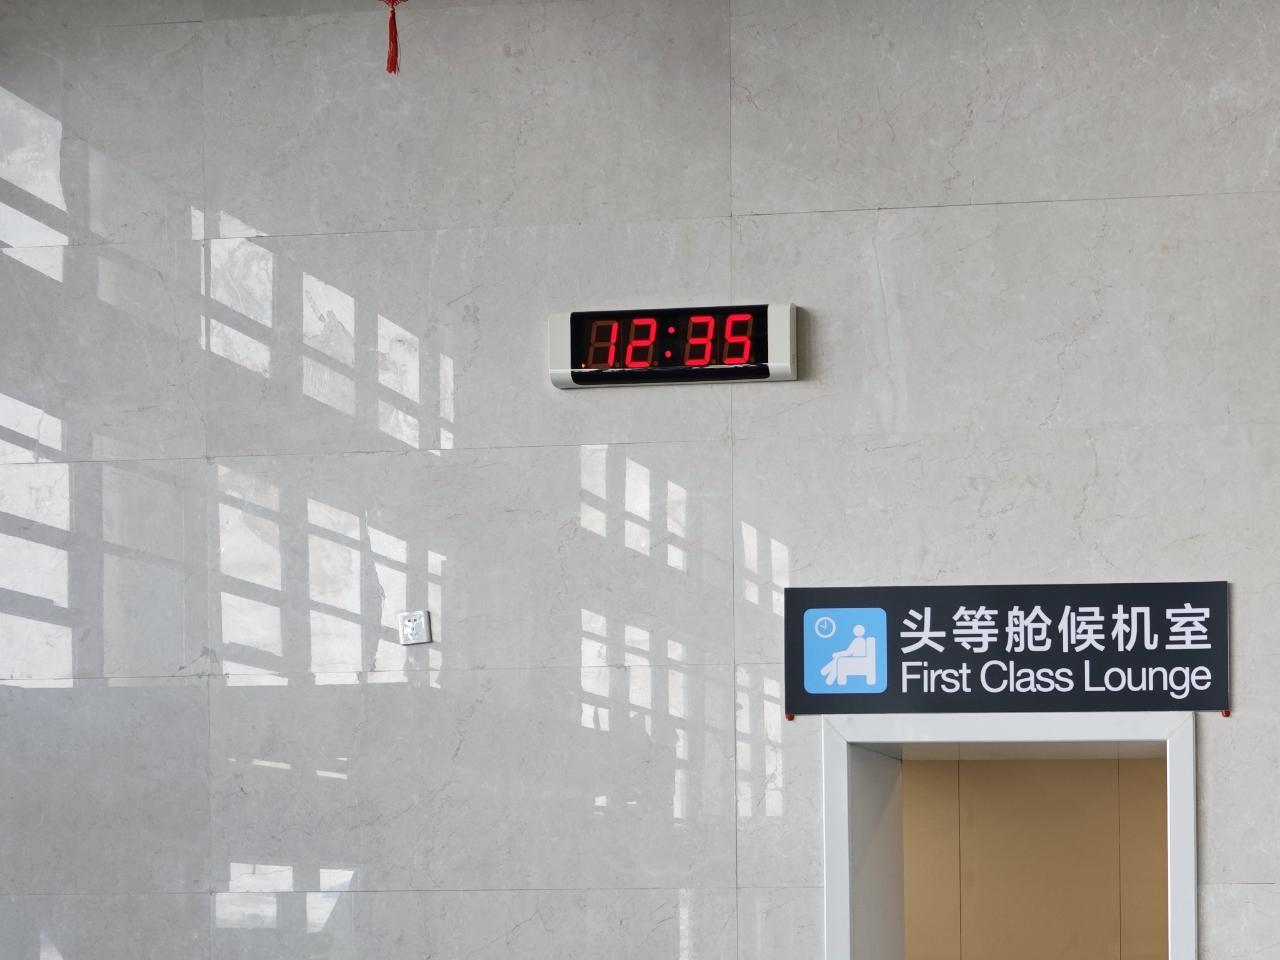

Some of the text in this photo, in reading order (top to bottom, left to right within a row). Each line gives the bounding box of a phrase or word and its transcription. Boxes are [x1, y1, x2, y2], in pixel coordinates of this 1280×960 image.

[607, 314, 753, 368] 12:35
[899, 602, 1212, 654] 头等舱候机室
[901, 659, 1212, 700] First Class Lounge
